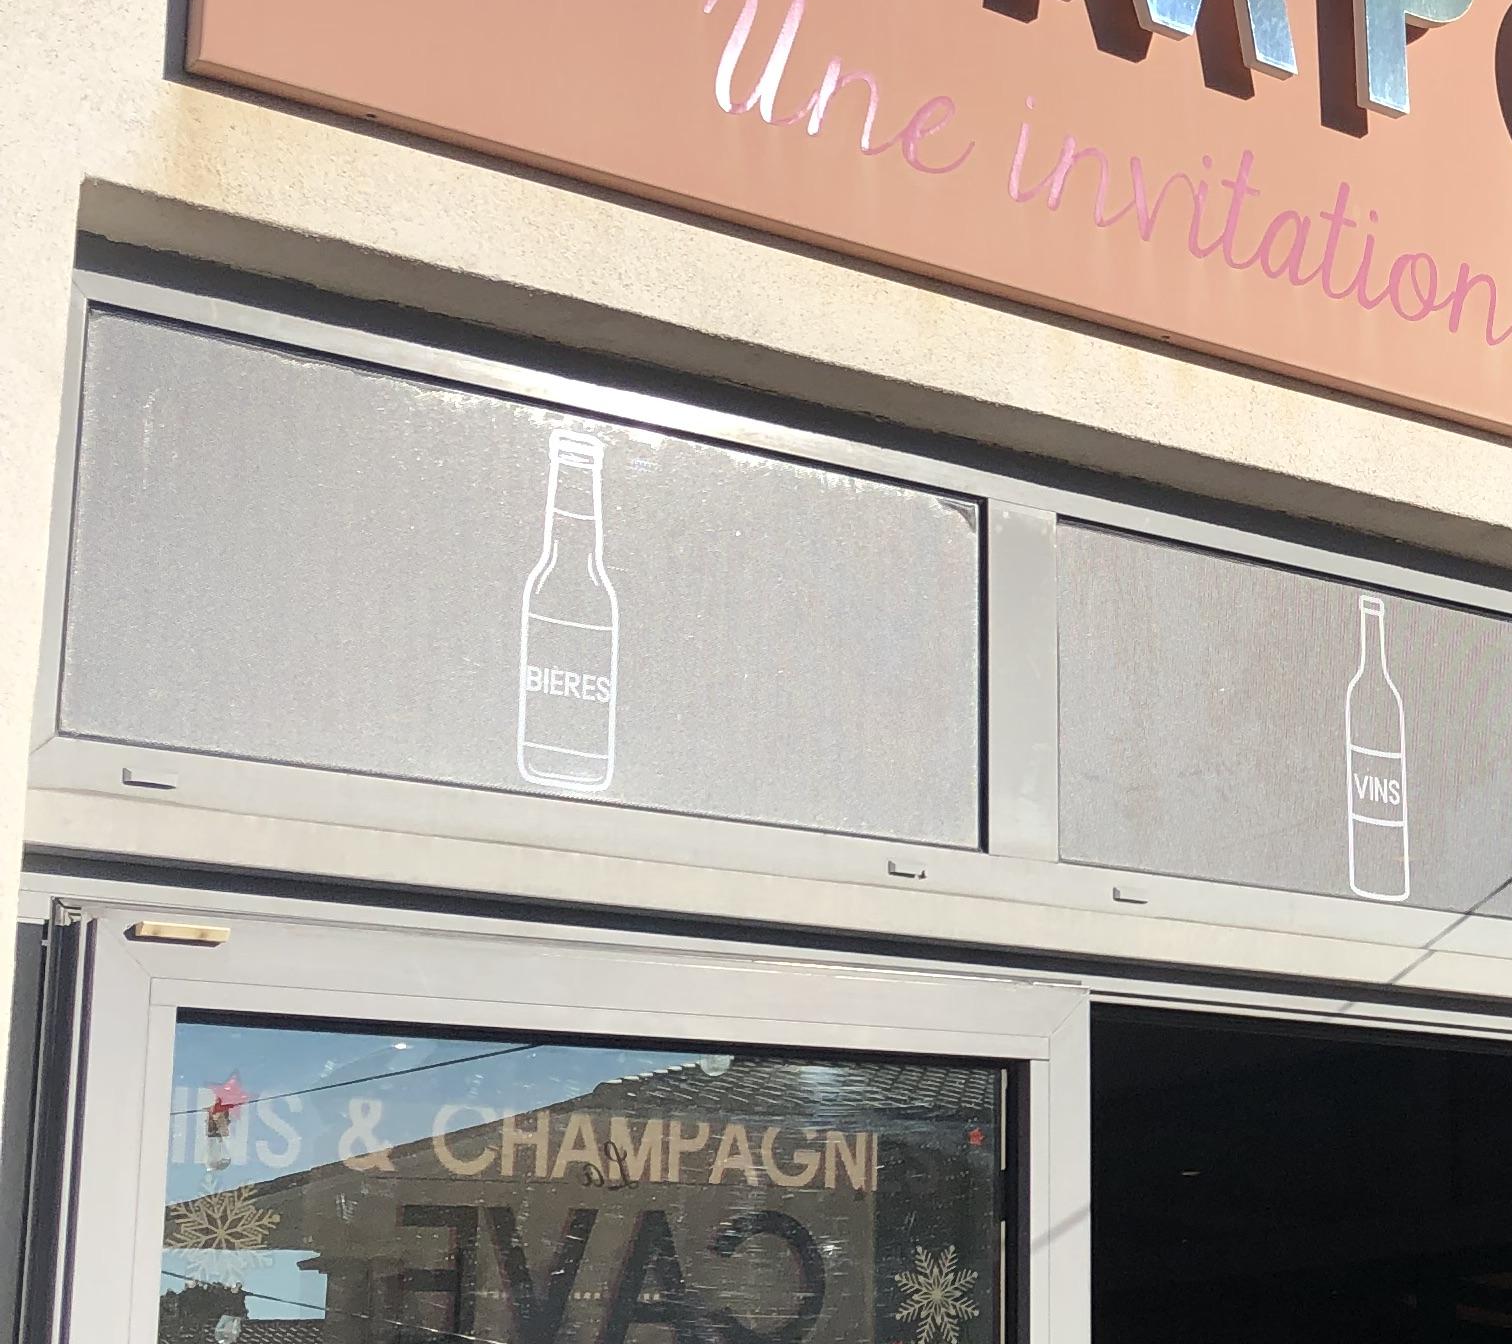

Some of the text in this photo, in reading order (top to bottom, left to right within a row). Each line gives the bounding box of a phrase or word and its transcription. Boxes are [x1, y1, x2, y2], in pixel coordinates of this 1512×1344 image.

[1353, 772, 1400, 806] VINS
[338, 1095, 399, 1173] &
[431, 1103, 878, 1192] CHAMPAGN
